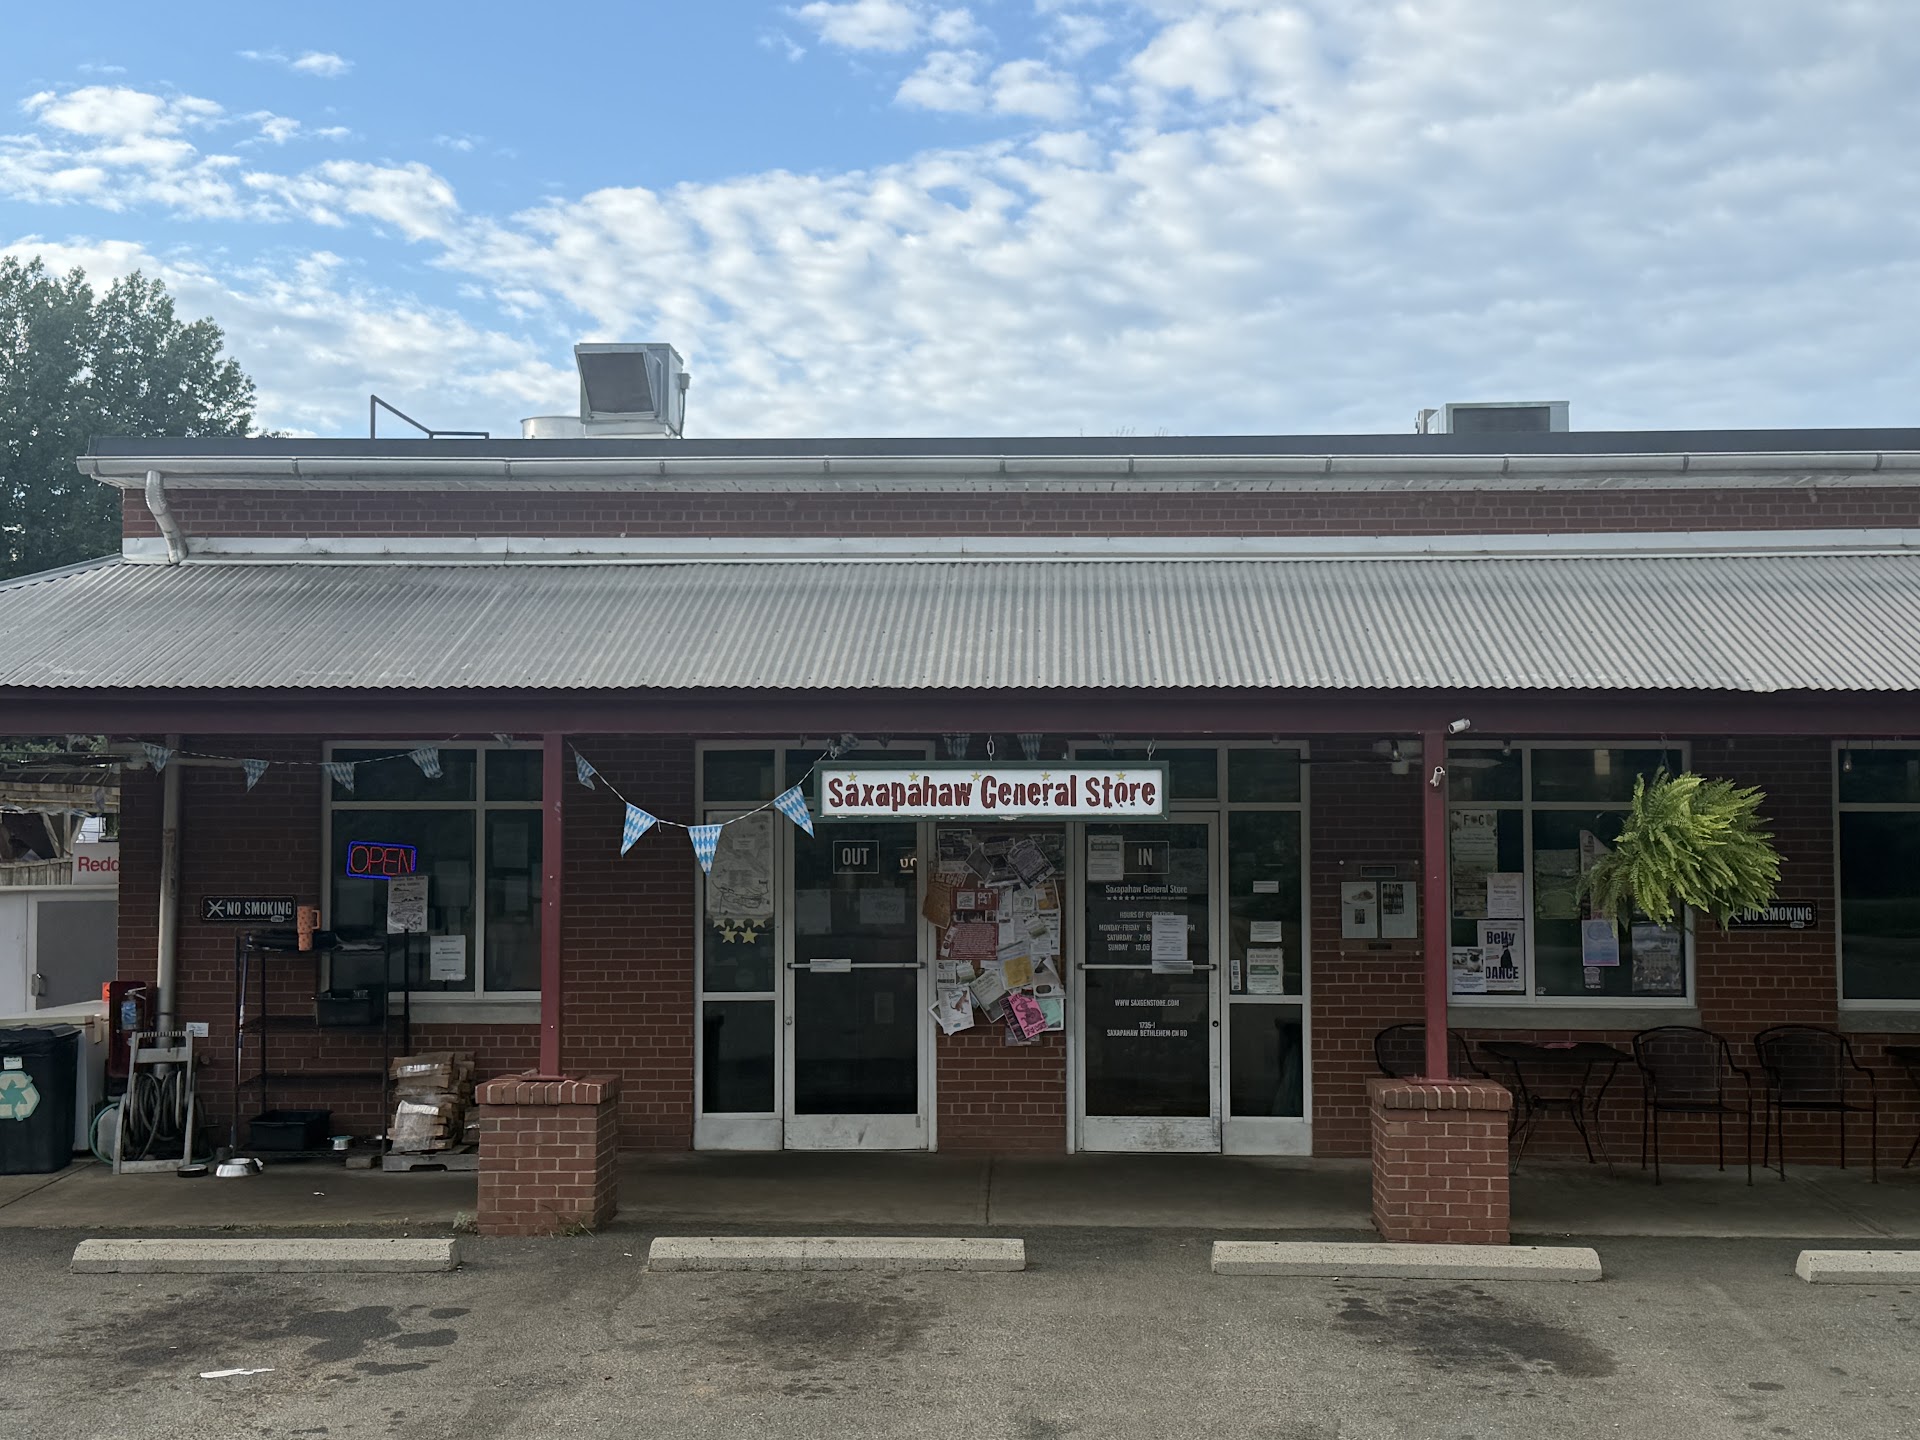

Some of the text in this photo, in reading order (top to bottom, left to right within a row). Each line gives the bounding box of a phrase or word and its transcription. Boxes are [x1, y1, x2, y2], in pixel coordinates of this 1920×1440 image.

[828, 775, 1156, 811] Saxapahaw General Store
[350, 845, 414, 876] OPEN
[841, 847, 870, 866] OUT
[1138, 848, 1153, 866] IN
[1105, 884, 1188, 895] Saxapahaw General Store
[226, 901, 292, 916] NO SMOKING
[1119, 911, 1137, 919] HOURS
[1137, 911, 1144, 919] OF
[1743, 907, 1813, 921] NO SMOKING
[1107, 943, 1129, 951] SUNDAY
[1485, 966, 1519, 979] DANCE
